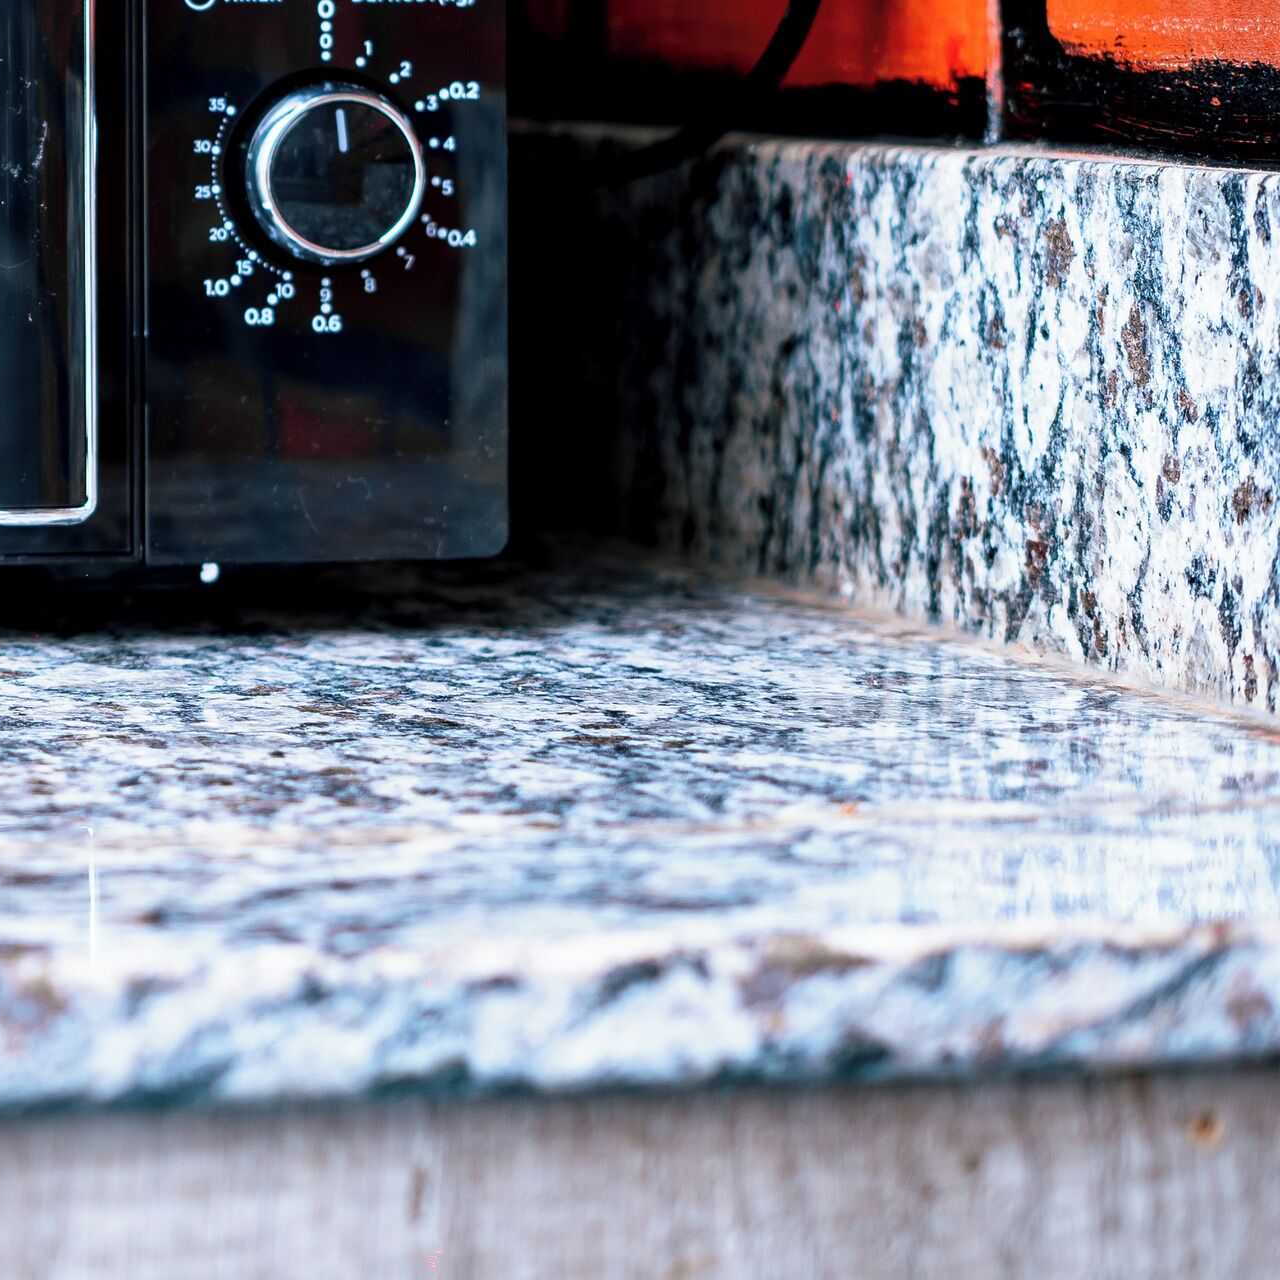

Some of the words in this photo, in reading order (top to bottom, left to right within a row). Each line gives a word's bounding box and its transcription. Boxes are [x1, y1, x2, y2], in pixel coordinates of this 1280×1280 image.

[319, 33, 333, 50] 0
[363, 40, 372, 56] 1
[399, 61, 411, 77] 2
[449, 81, 480, 100] 0.2
[208, 97, 226, 112] 35
[426, 94, 439, 111] 3
[193, 139, 212, 153] 30
[442, 136, 456, 151] 4
[194, 185, 212, 199] 25
[441, 179, 454, 196] 5
[209, 228, 227, 241] 20
[425, 221, 437, 238] 6
[447, 229, 477, 247] 0.4
[235, 260, 253, 276] 15
[403, 254, 415, 270] 7
[203, 278, 229, 296] 1.0
[275, 282, 295, 299] 10
[364, 277, 377, 293] 8
[319, 288, 332, 303] 9
[244, 307, 274, 325] 0.8
[312, 314, 342, 332] 0.6
